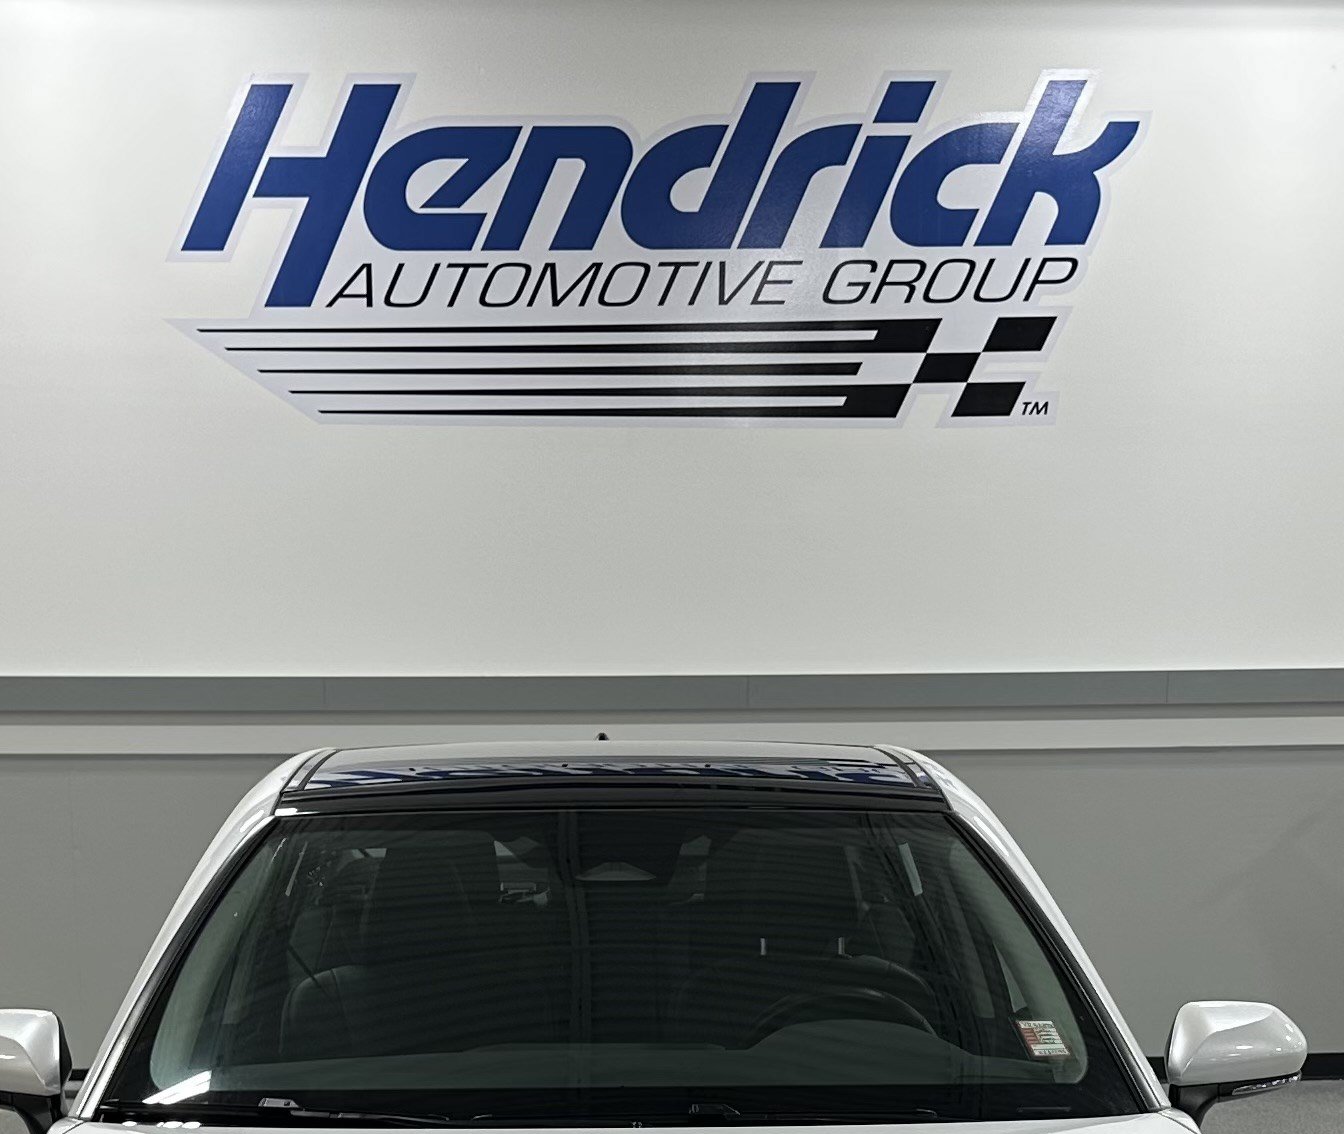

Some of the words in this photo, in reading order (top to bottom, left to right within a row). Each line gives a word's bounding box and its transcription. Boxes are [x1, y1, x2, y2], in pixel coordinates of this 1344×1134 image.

[181, 80, 1139, 308] Hendrick
[325, 258, 794, 308] AUTOMOTIVE
[822, 257, 1079, 305] GROUP
[1022, 401, 1049, 415] TM
